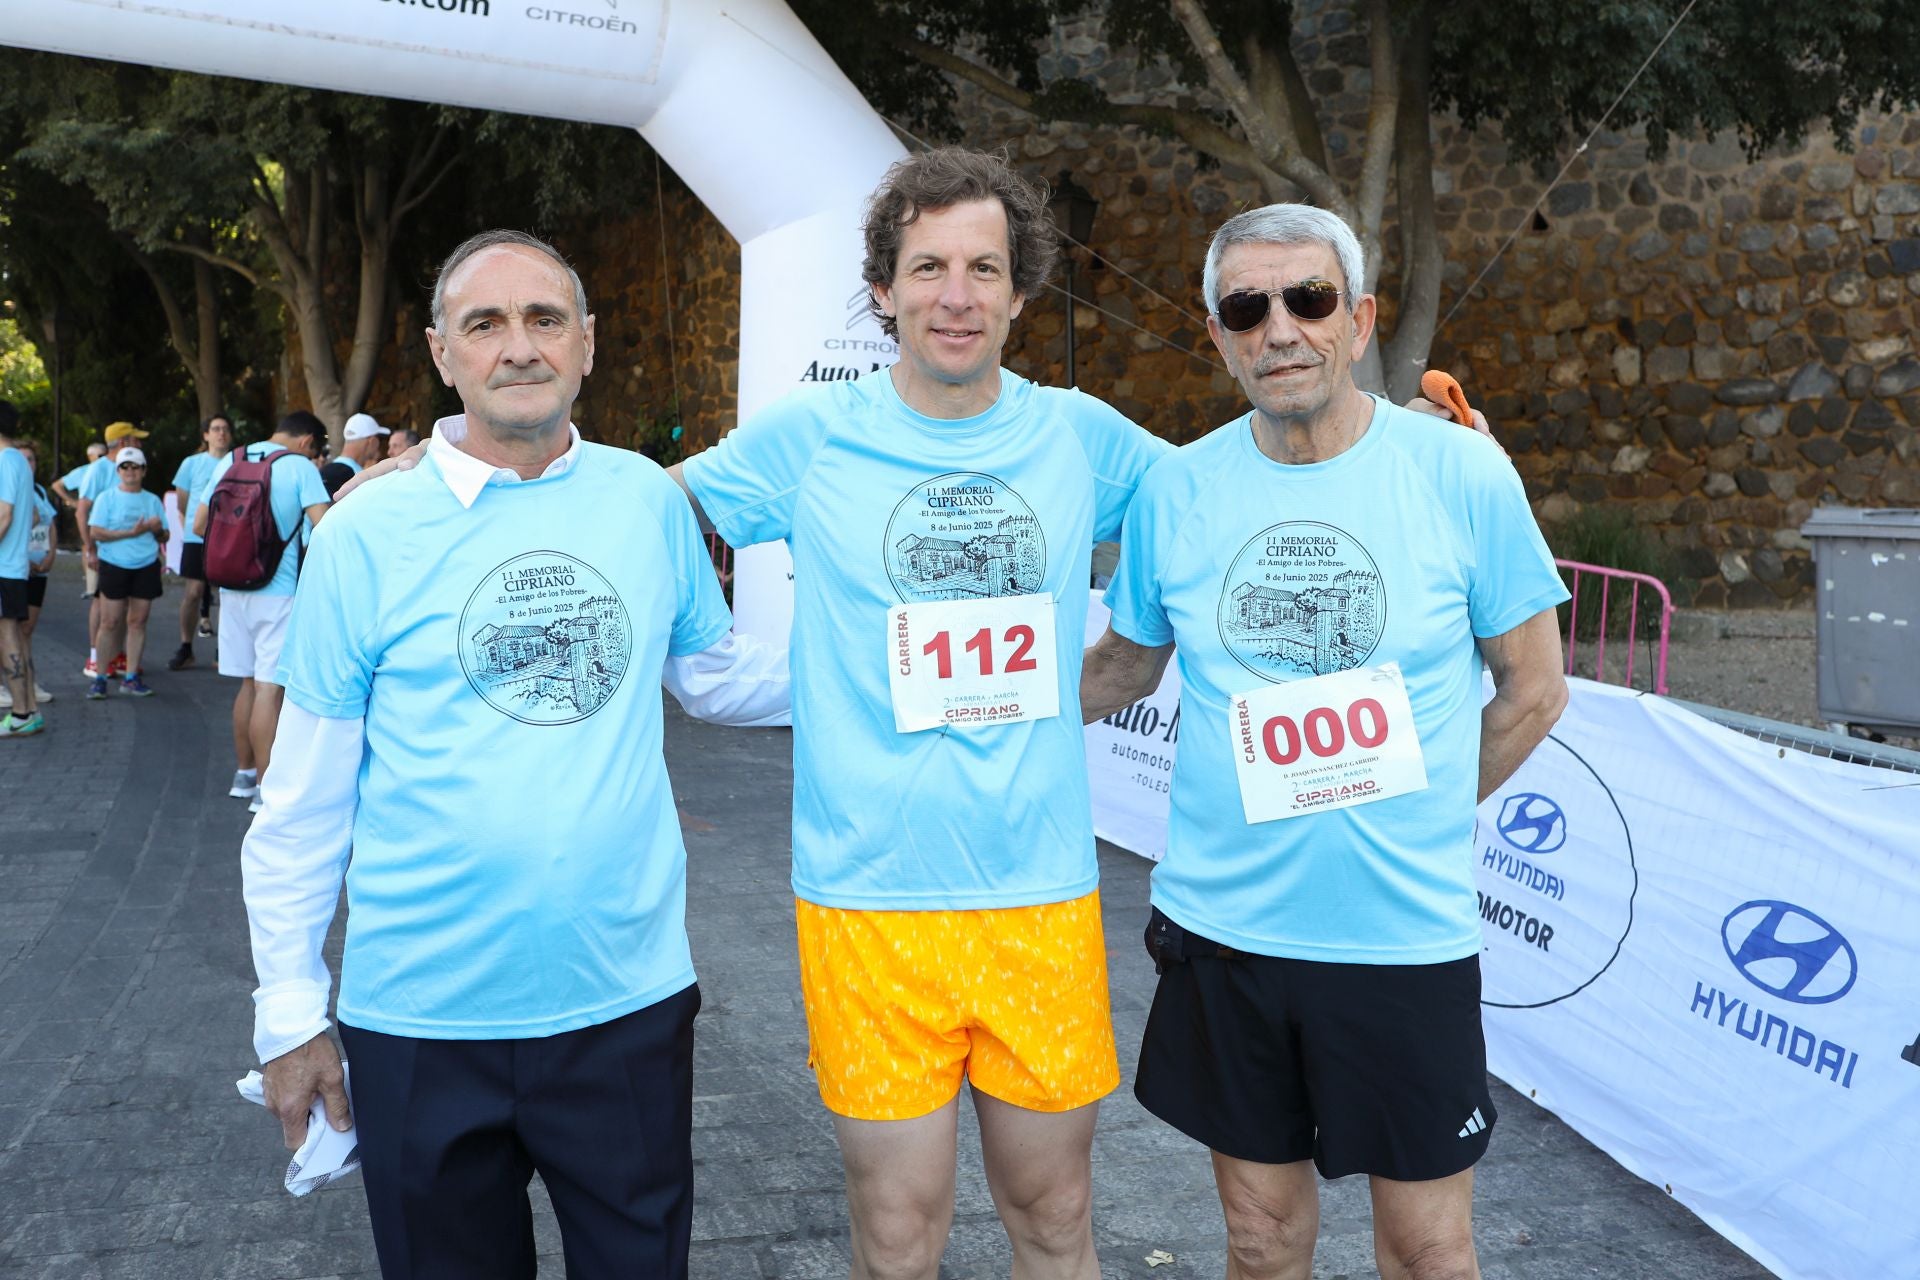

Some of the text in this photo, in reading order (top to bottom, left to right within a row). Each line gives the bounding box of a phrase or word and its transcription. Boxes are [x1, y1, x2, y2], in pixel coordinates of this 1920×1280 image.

[941, 485, 995, 496] MEMORIAL
[928, 495, 993, 508] CIPRIANO
[931, 510, 956, 518] Amigo
[957, 508, 967, 516] de
[930, 523, 936, 532] 8
[949, 522, 972, 532] Junio
[974, 521, 993, 530] 2025
[1281, 536, 1339, 545] MEMORIAL
[1266, 545, 1336, 557] CIPRIANO
[1267, 559, 1292, 568] Amigo
[518, 565, 576, 579] MEMORIAL
[1265, 573, 1329, 582] 8 de Junio 2025
[504, 574, 575, 592] CIPRIANO
[508, 593, 535, 603] Amigo
[548, 589, 559, 597] los
[509, 610, 515, 619] 8
[528, 605, 553, 617] Junio
[553, 603, 574, 613] 2025
[897, 611, 911, 676] CARRERA
[922, 624, 1037, 679] 112
[954, 695, 986, 703] CARRERA
[993, 690, 1019, 699] MARCHA
[945, 703, 1020, 718] CIPRIANO
[1236, 699, 1256, 764] CARRERA
[1262, 697, 1389, 766] 000
[1349, 756, 1379, 767] GARRIDO
[1303, 775, 1336, 786] CARRERA
[1343, 767, 1373, 778] MARCHA
[1295, 780, 1376, 803] CIPRIANO
[1302, 800, 1325, 808] AMIGO
[1337, 794, 1351, 802] LOS
[1482, 845, 1565, 901] HYUNDAI
[1690, 981, 1859, 1089] HYUNDAI
